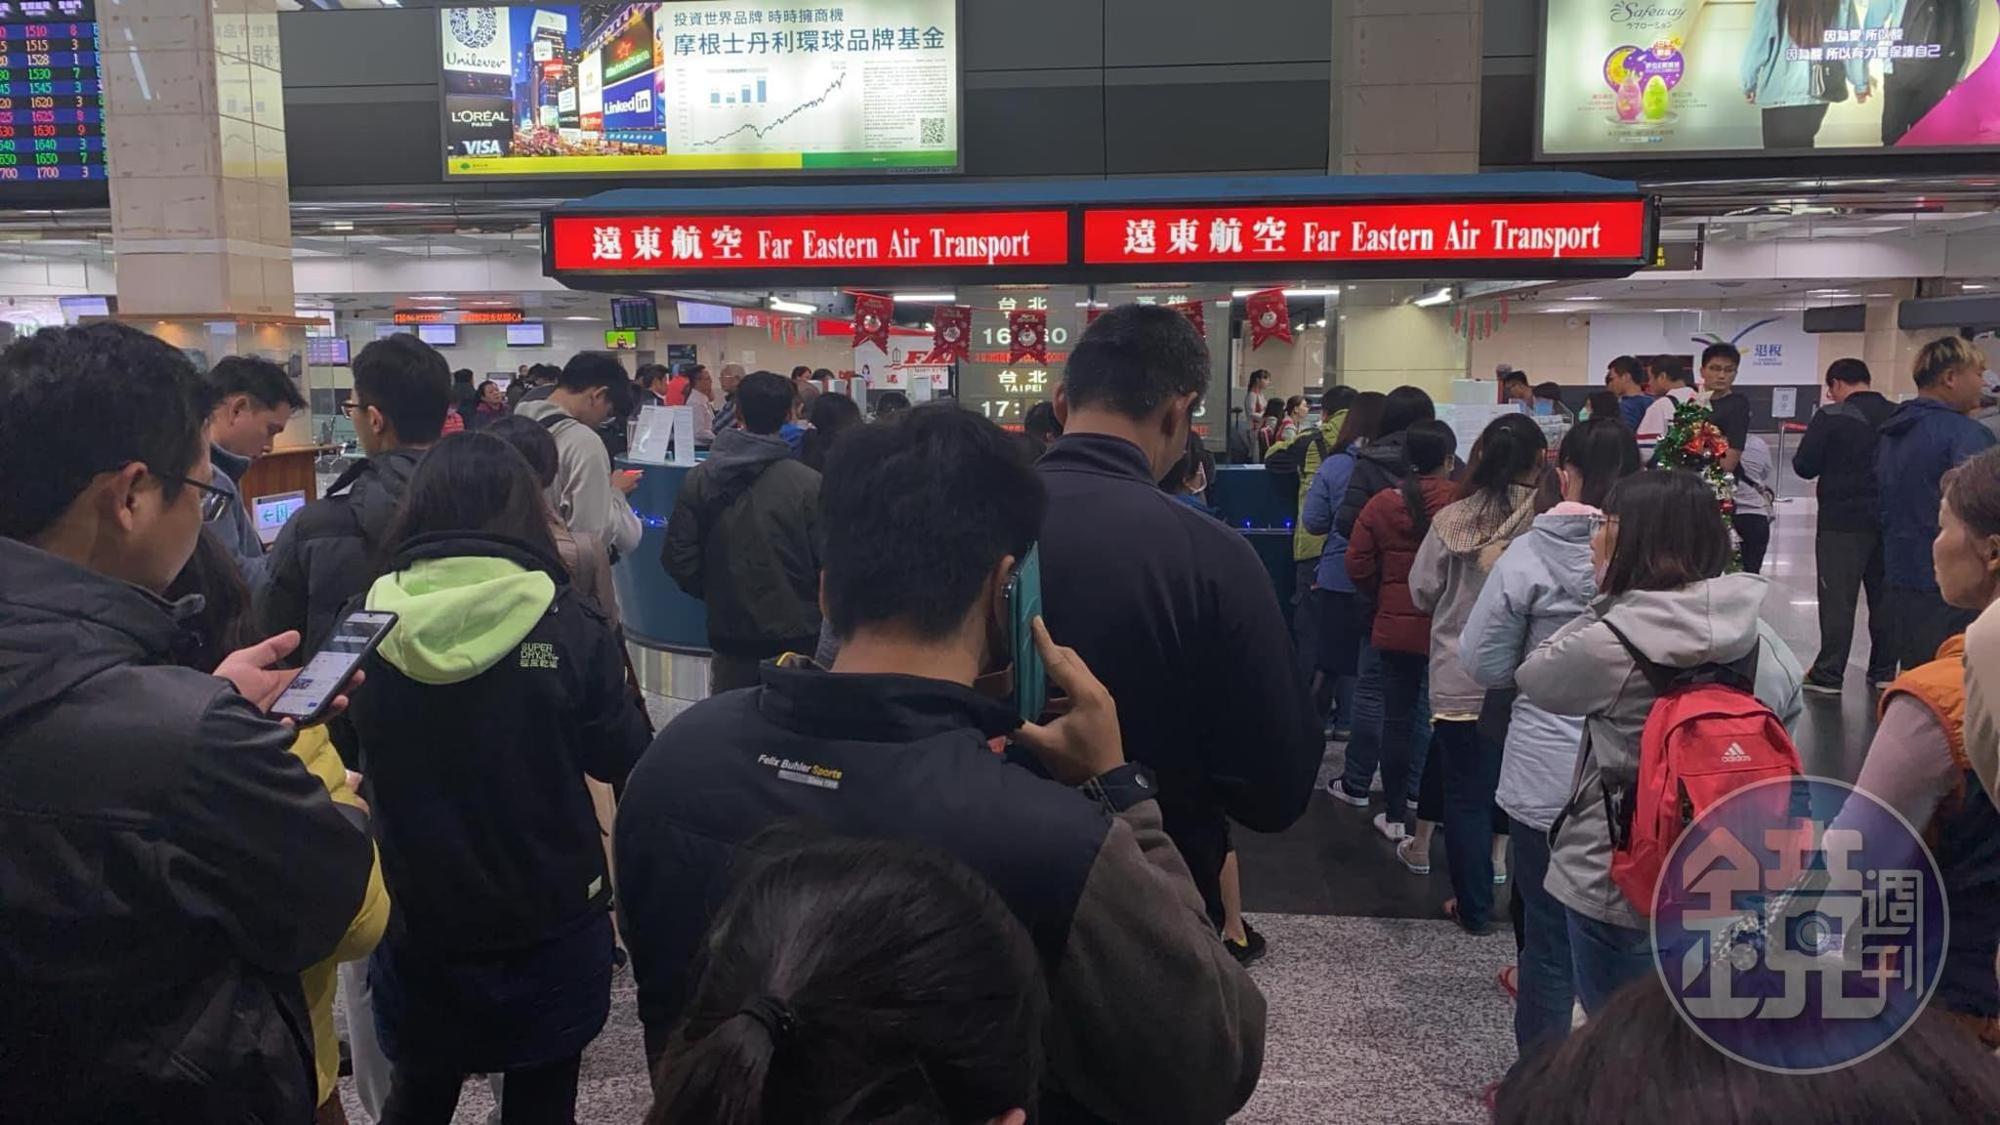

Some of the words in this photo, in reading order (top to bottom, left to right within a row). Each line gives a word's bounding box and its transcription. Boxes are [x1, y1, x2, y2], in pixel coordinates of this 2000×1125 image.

[673, 10, 763, 27] 投資世界品牌
[25, 24, 47, 37] 1510
[26, 40, 48, 51] 1515
[71, 39, 78, 50] 3
[673, 25, 945, 56] 摩根士丹利環球品牌基金
[74, 53, 79, 65] 1
[446, 51, 505, 69] Unilever
[28, 68, 51, 80] 1530
[73, 67, 80, 79] 7
[30, 83, 52, 94] 1545
[74, 82, 82, 93] 3
[31, 96, 53, 108] 1620
[76, 96, 83, 107] 3
[33, 125, 55, 136] 1630
[78, 124, 86, 136] 9
[0, 139, 15, 151] 640
[35, 139, 57, 150] 1640
[80, 138, 87, 150] 3
[462, 139, 502, 155] VISA
[0, 154, 16, 165] 650
[36, 153, 58, 165] 1650
[80, 153, 88, 164] 7
[0, 167, 18, 179] 700
[37, 167, 59, 179] 1700
[81, 166, 88, 178] 3
[1123, 216, 1287, 255] 遠東航空
[1302, 222, 1340, 253] Far
[1352, 221, 1433, 252] Eastern
[1444, 219, 1479, 251] Air
[1493, 219, 1601, 258] Transport
[592, 226, 743, 262] 遠東航空
[758, 230, 793, 260] Far
[803, 229, 877, 260] Eastern
[888, 228, 920, 259] Air
[929, 228, 1030, 265] Transport
[998, 297, 1047, 310] 台北
[998, 370, 1047, 383] 台北
[1004, 384, 1043, 393] TAIPEI
[1721, 755, 1751, 763] adidas
[757, 753, 781, 767] Felix
[811, 764, 843, 780] Sports
